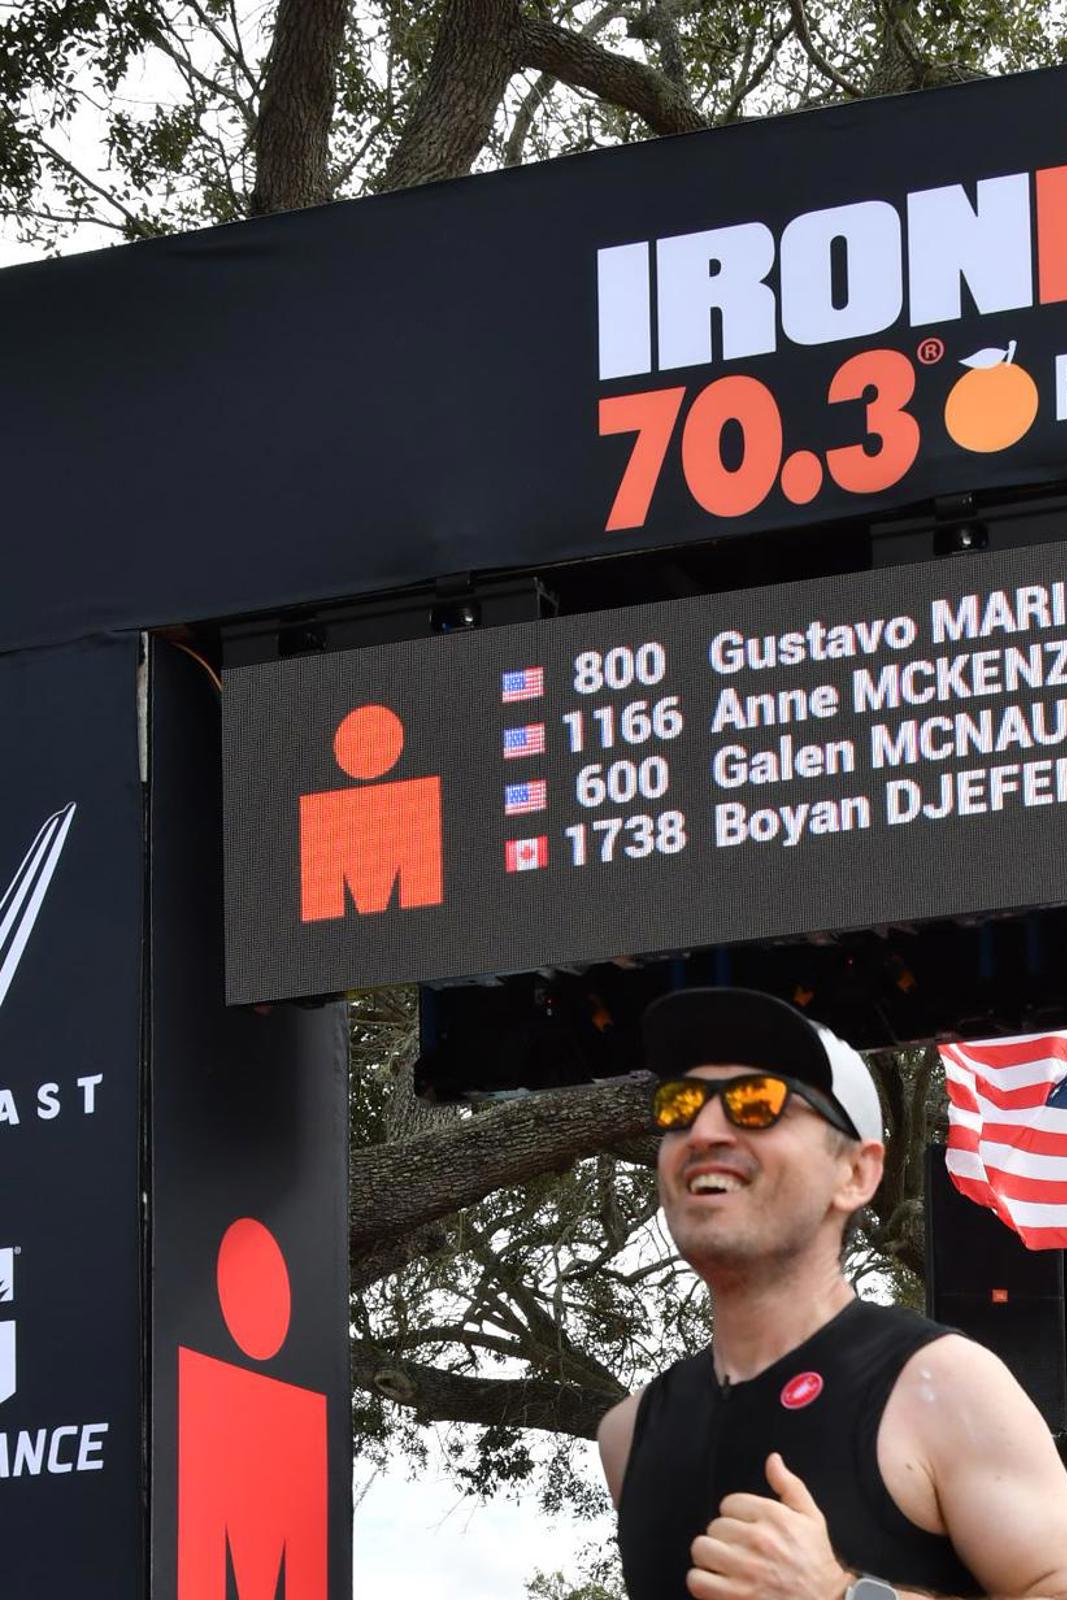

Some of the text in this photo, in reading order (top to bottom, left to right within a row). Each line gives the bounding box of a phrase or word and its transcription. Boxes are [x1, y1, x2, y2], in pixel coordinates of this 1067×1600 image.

[598, 348, 922, 533] 70.3
[573, 642, 667, 695] 800
[709, 615, 918, 675] Gustavo
[562, 696, 684, 752] 1166
[711, 684, 840, 733] Anne
[576, 755, 669, 808] 600
[713, 733, 856, 789] Galen
[564, 809, 687, 867] 1738
[715, 795, 872, 848] Boyan
